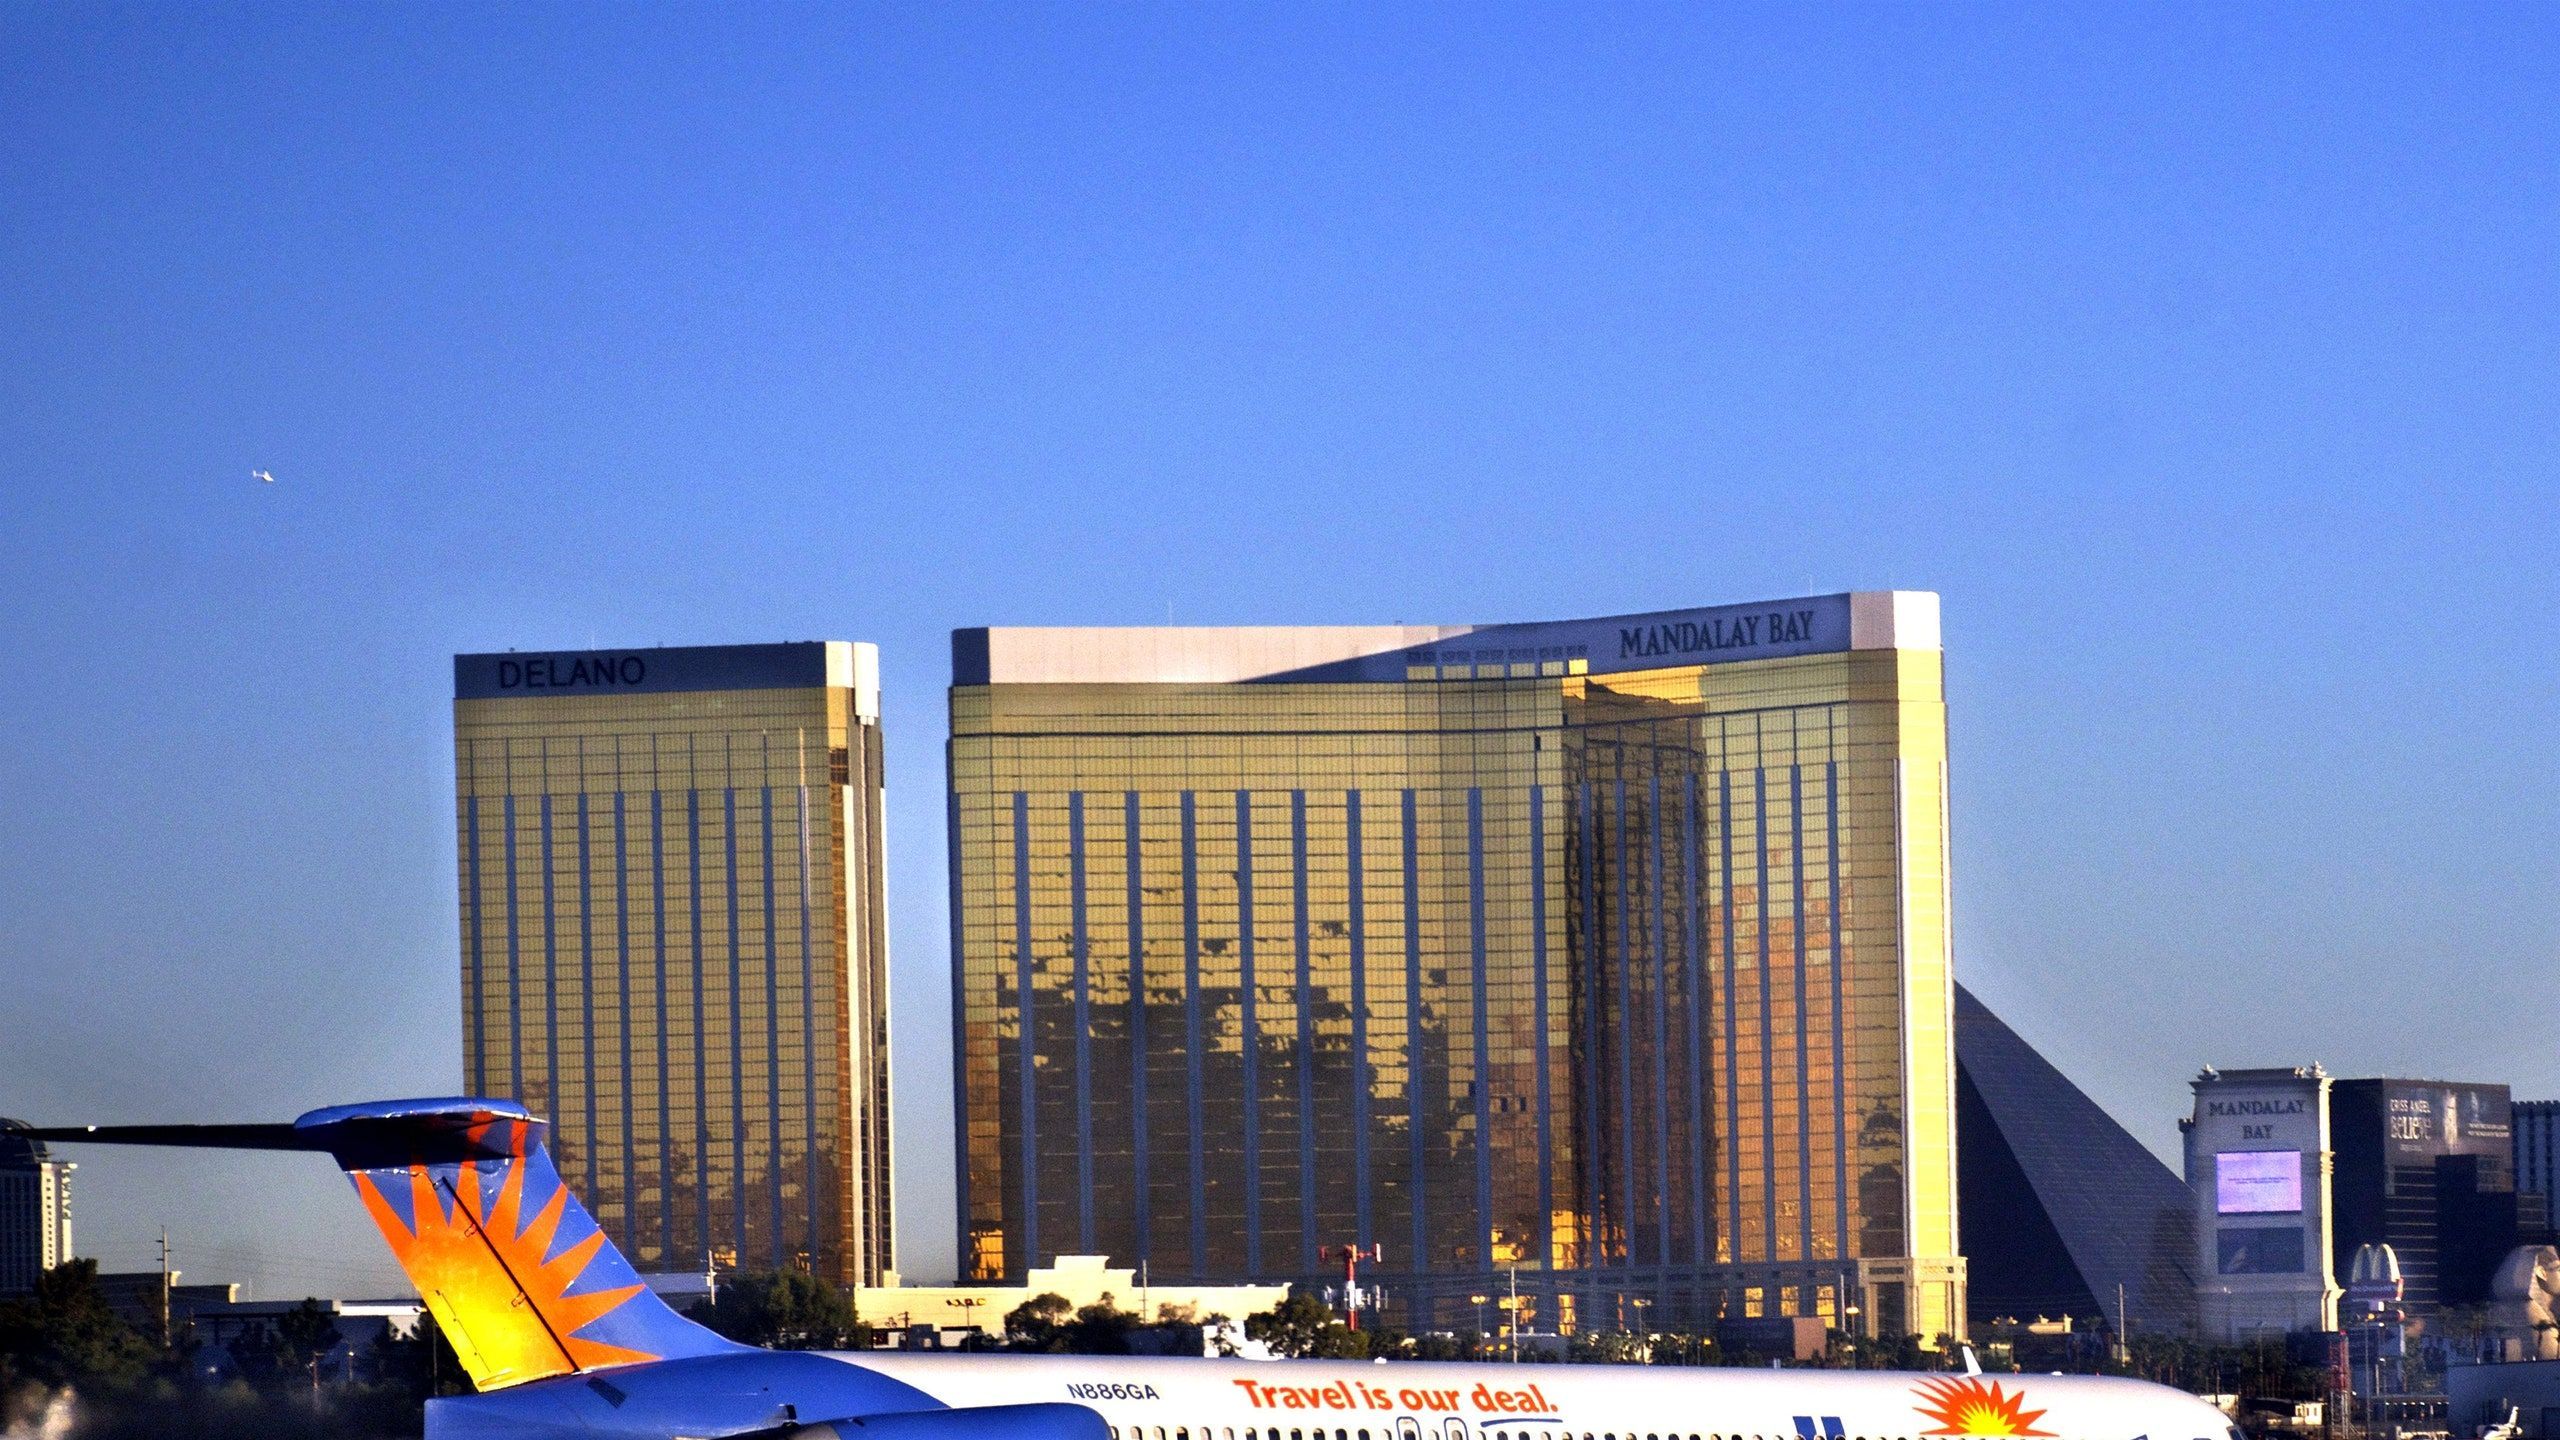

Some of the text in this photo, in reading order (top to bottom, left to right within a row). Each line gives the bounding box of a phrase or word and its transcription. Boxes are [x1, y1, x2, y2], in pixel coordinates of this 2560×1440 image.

[1619, 610, 1814, 658] MANDALAY BAY
[500, 656, 645, 688] DELANO
[2208, 1100, 2305, 1116] MANDALAY
[2242, 1125, 2273, 1139] BAY
[1066, 1383, 1160, 1400] N886GA
[1232, 1380, 1558, 1412] Travel is our deal.
